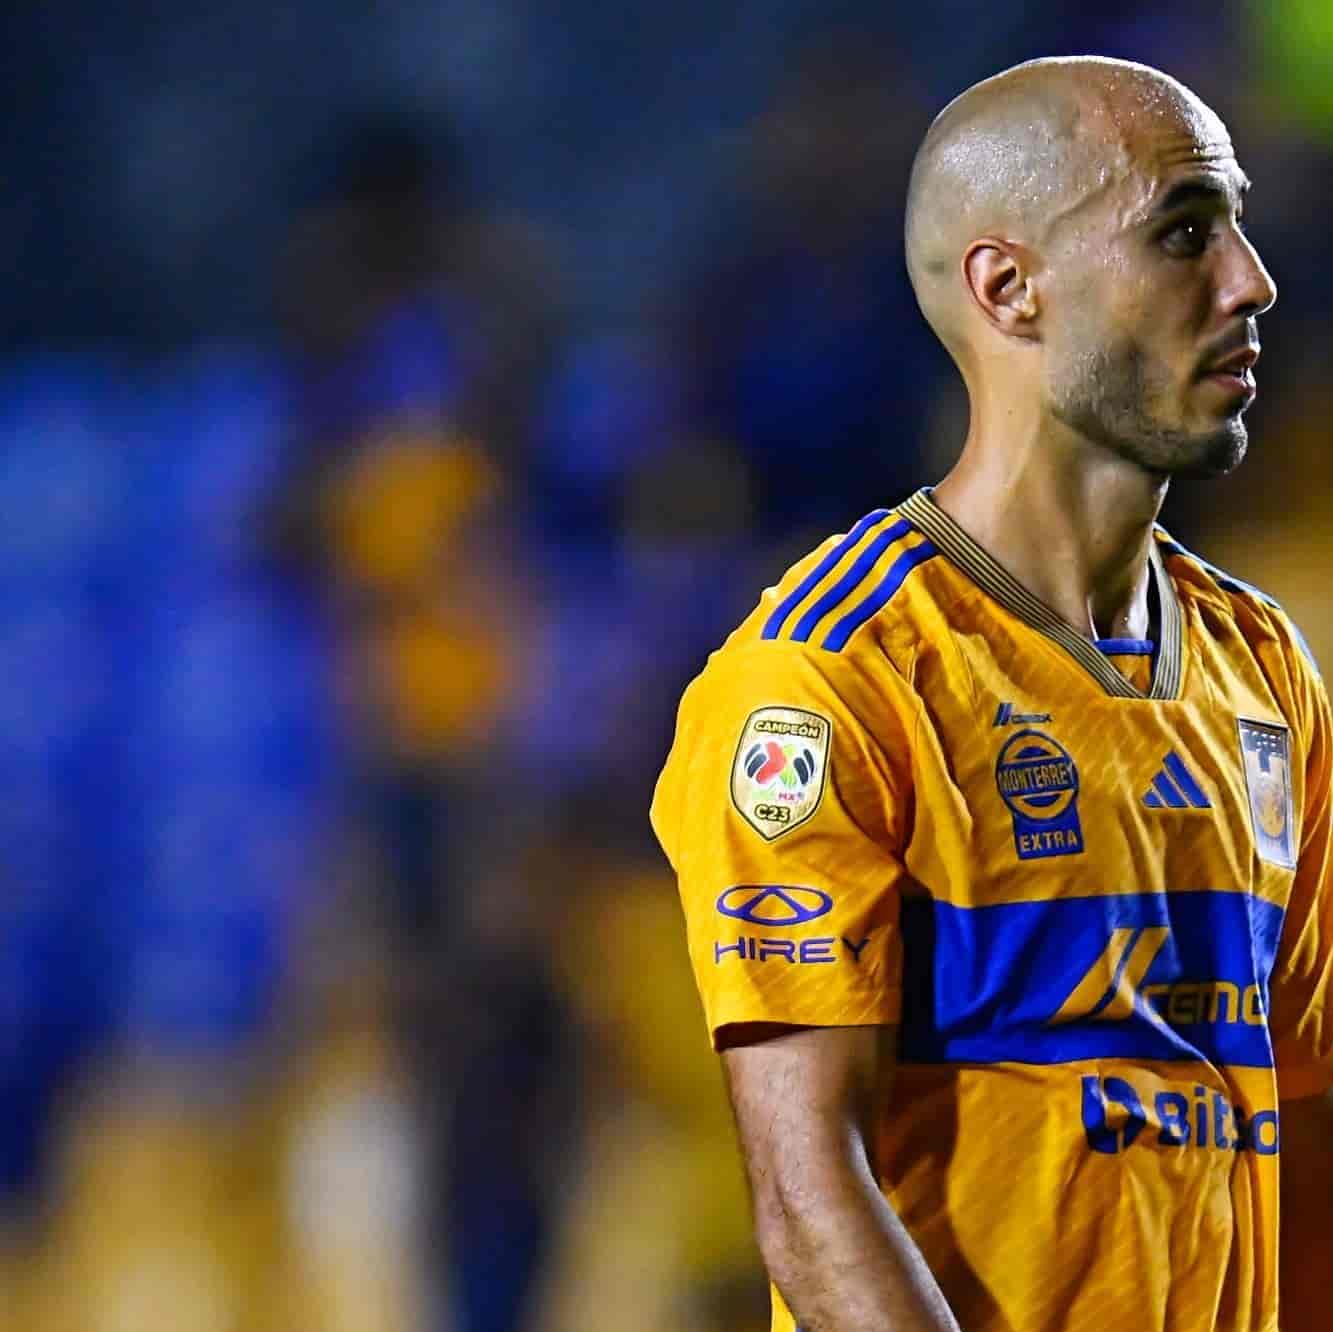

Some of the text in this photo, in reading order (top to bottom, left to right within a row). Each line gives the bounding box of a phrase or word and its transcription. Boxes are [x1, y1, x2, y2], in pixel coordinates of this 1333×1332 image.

[754, 719, 821, 739] CAMPEÓN
[754, 803, 791, 822] C23
[1019, 829, 1079, 853] EXTRA
